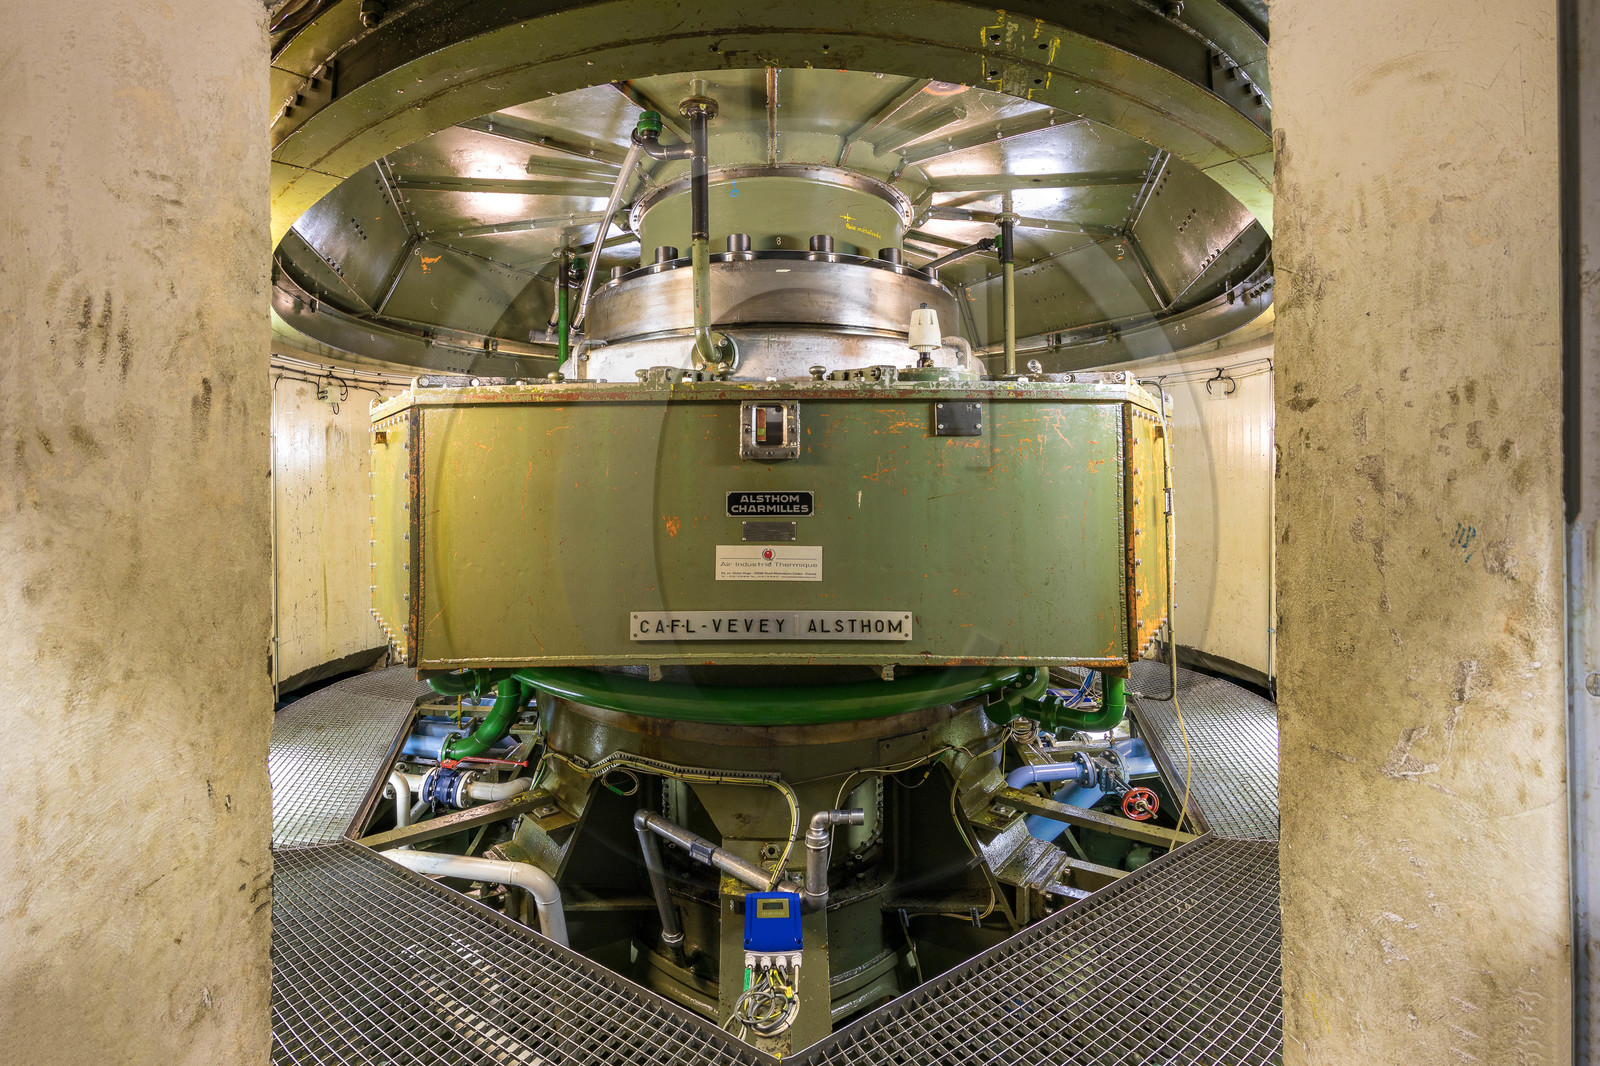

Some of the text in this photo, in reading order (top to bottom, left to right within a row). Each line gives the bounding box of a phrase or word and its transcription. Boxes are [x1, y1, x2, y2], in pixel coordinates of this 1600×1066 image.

[740, 494, 800, 503] ALSTHOM
[731, 504, 809, 513] CHARMILLES
[808, 619, 903, 633] ALSTHOM
